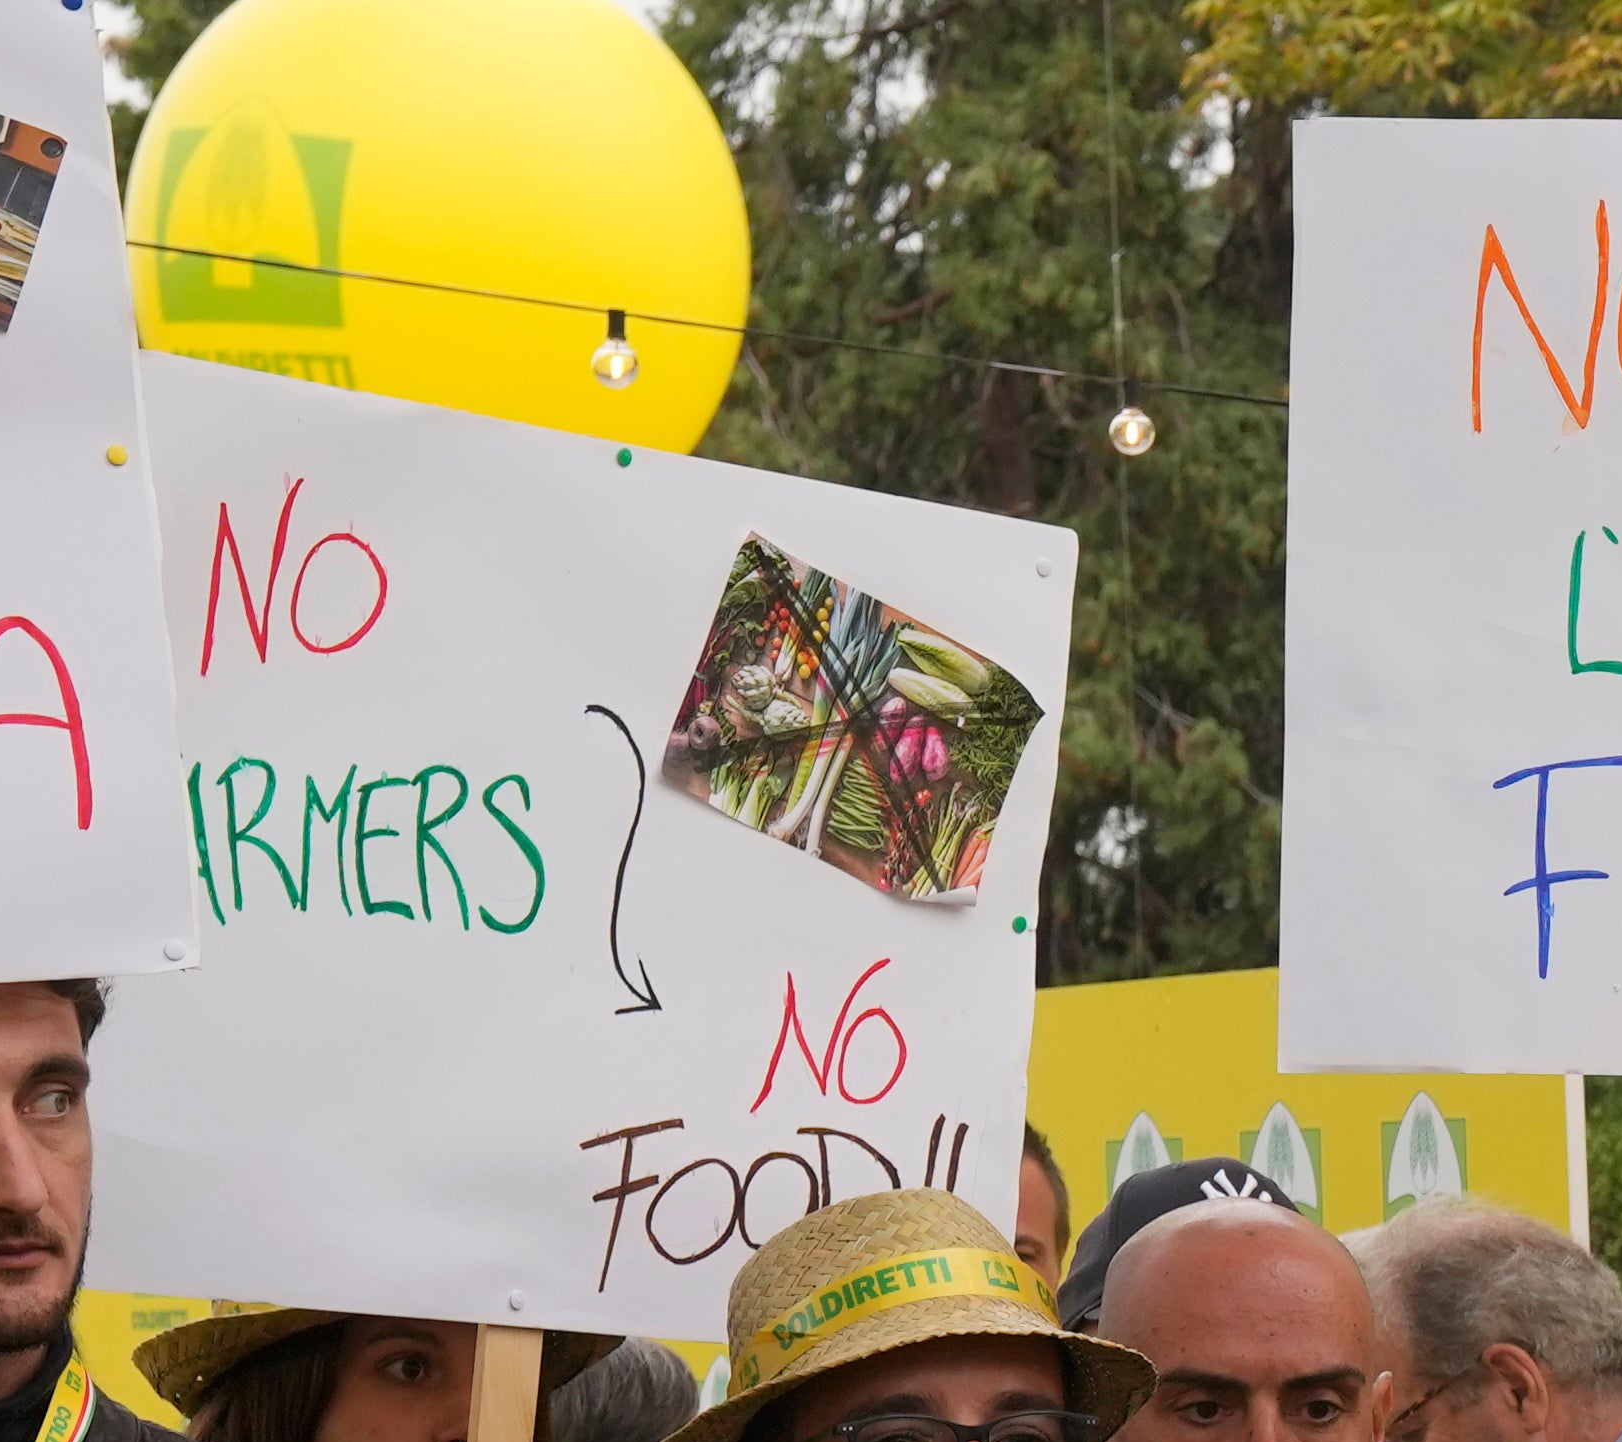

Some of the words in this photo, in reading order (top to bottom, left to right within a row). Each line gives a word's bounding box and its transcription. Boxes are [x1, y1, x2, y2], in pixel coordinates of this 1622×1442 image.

[201, 477, 388, 676] NO
[188, 751, 546, 934] RMERS
[750, 959, 906, 1115] NO
[771, 1256, 954, 1351] COLDIRETTI
